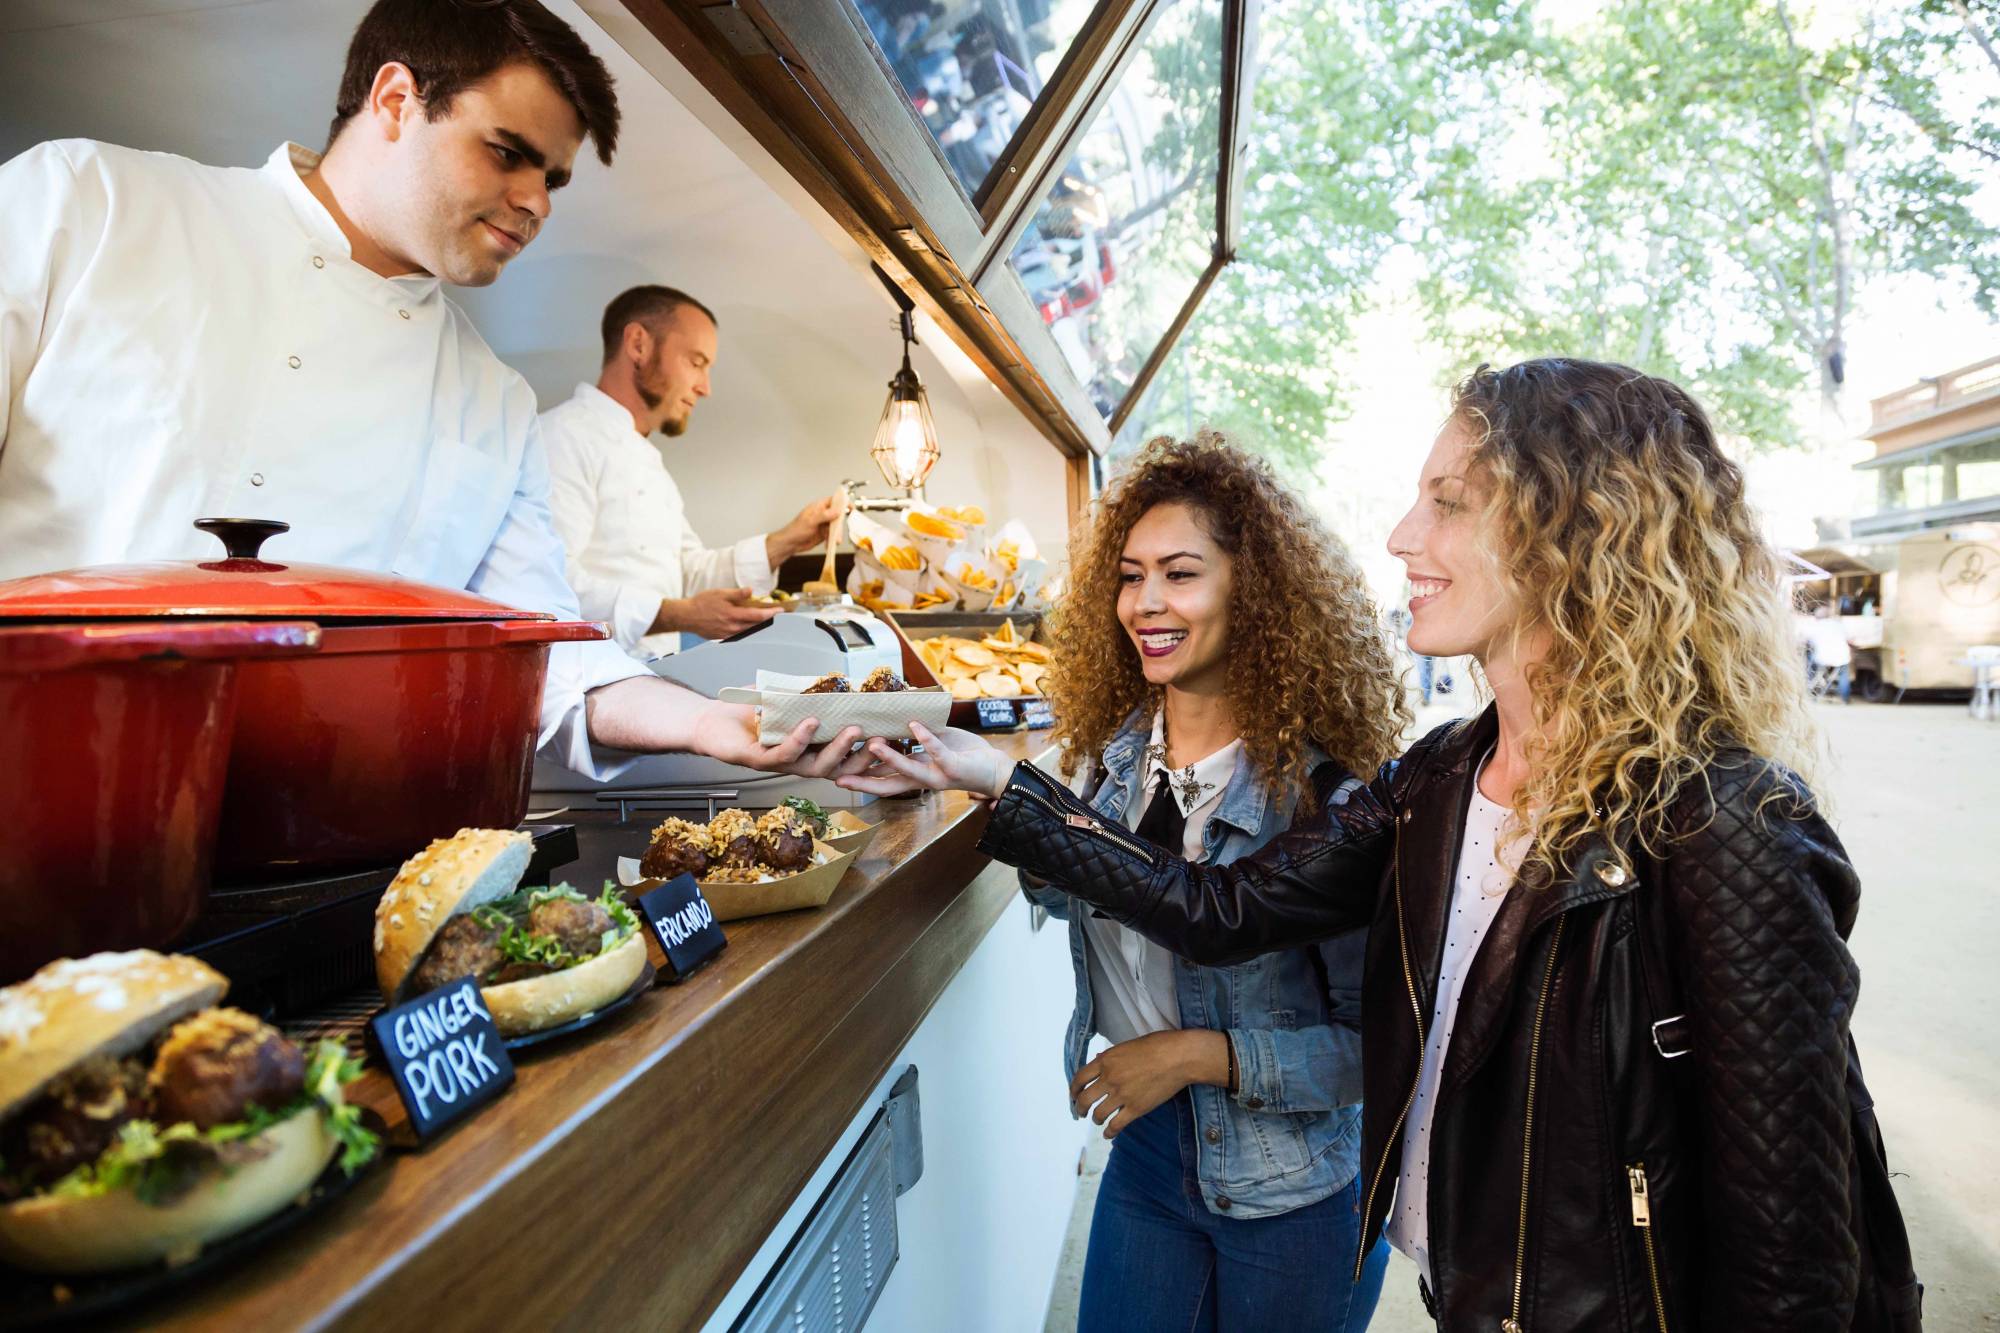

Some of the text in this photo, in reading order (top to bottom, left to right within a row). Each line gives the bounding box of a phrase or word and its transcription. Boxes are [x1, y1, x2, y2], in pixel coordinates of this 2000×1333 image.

[655, 887, 712, 950] FRICANDÓ
[394, 983, 492, 1059] GINGER
[404, 1031, 499, 1120] PORK
